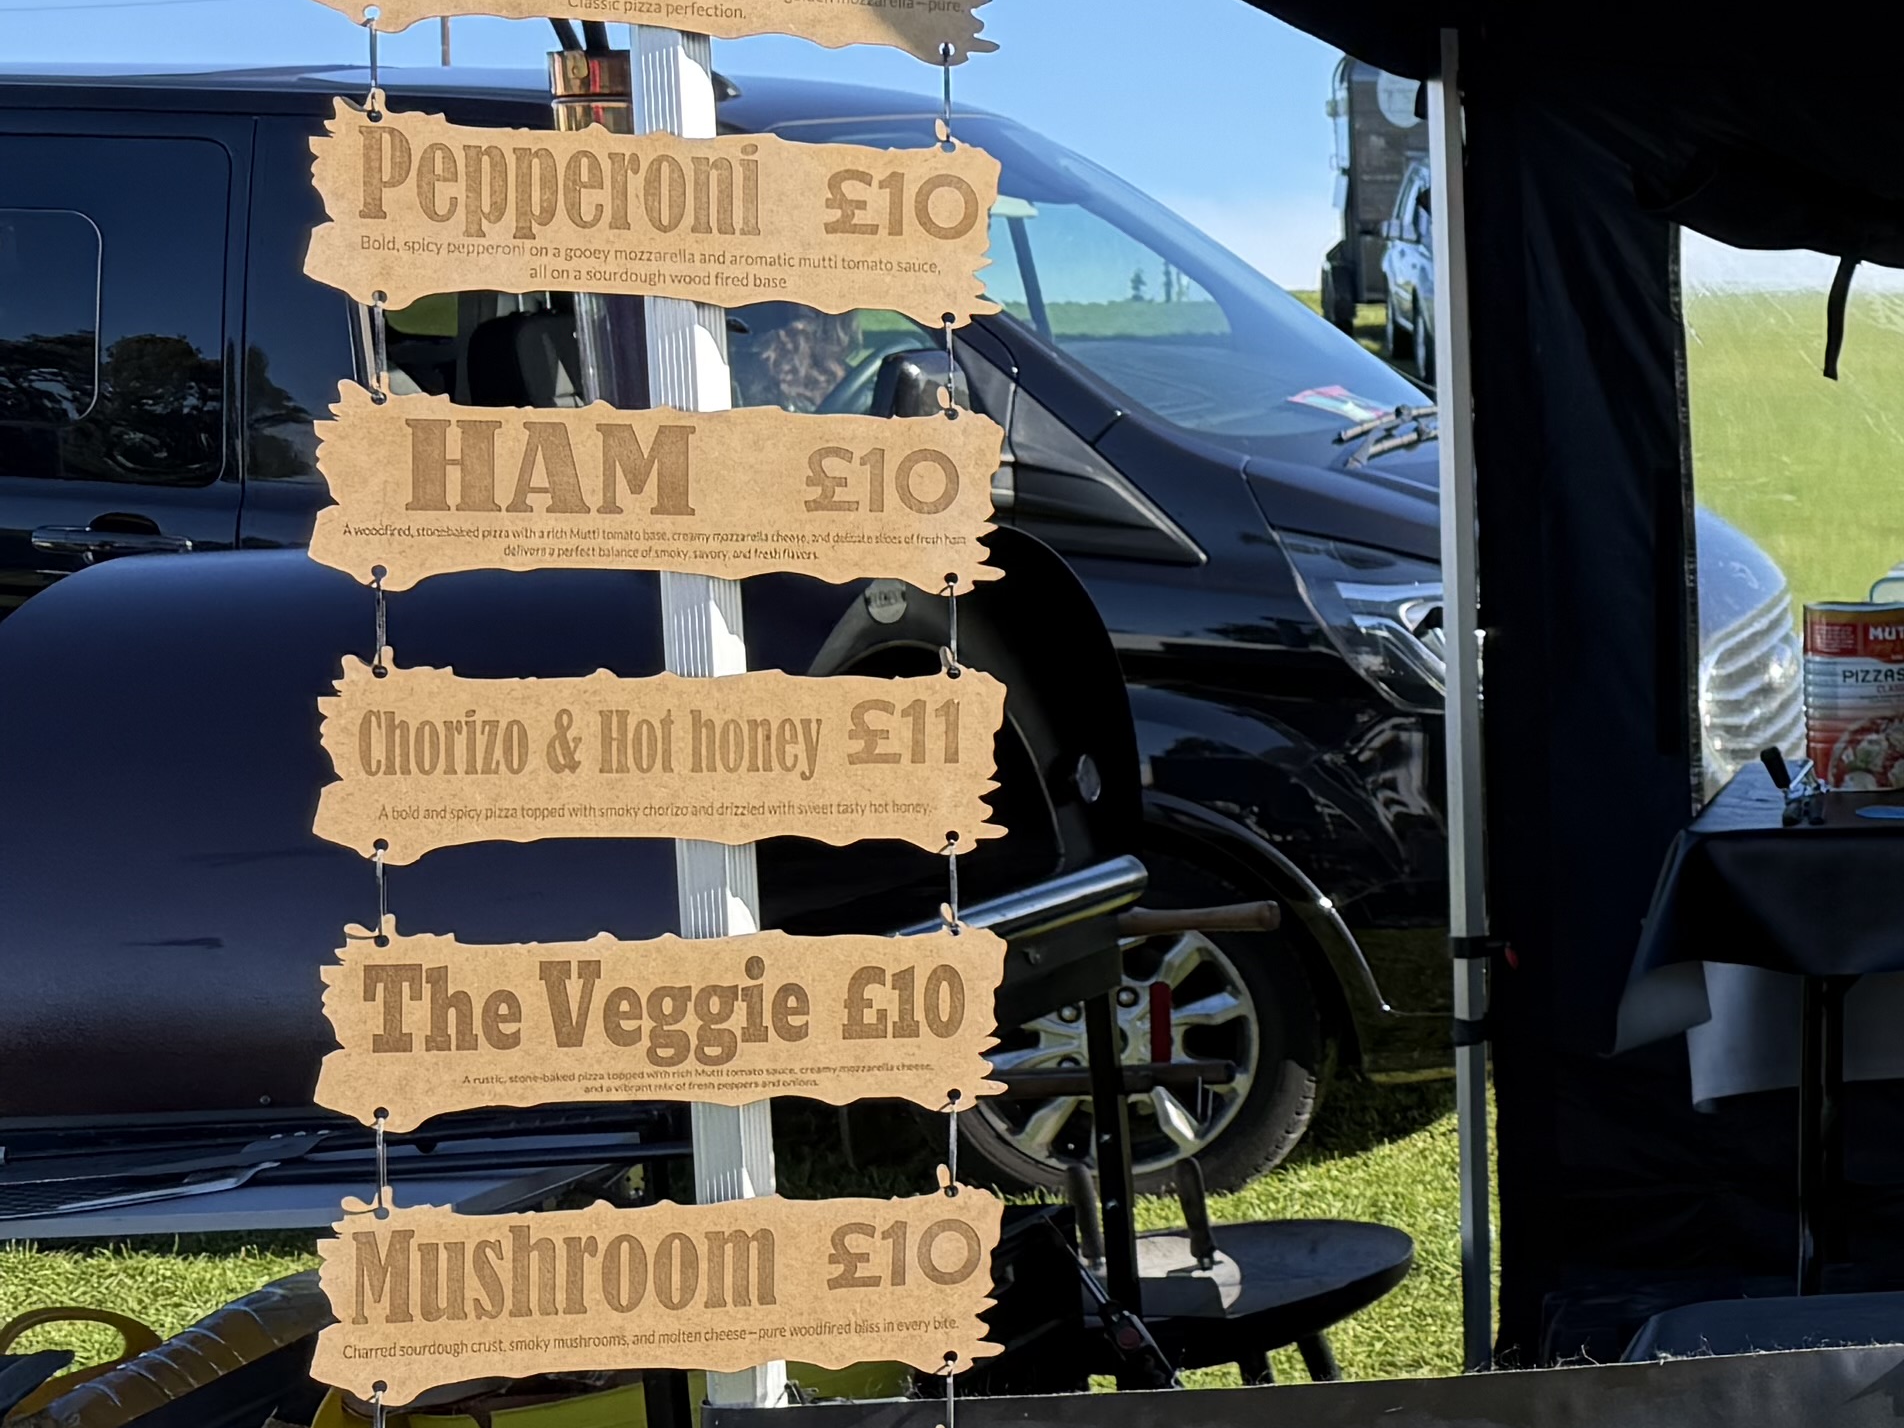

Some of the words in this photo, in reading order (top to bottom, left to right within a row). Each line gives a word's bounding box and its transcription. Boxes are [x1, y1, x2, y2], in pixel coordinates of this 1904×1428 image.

[624, 0, 662, 15] pizza
[666, 1, 746, 20] perfection.
[358, 126, 761, 239] Pepperoni
[824, 170, 978, 239] £10
[361, 235, 399, 252] Bold,
[404, 238, 442, 255] spicy
[447, 242, 525, 258] pepperoni
[530, 244, 548, 257] on
[553, 246, 561, 257] a
[565, 247, 608, 262] gooey
[615, 249, 695, 264] mozzarella
[699, 250, 726, 265] and
[730, 253, 794, 268] aromatic
[799, 254, 838, 269] mutti
[842, 258, 892, 272] tomato
[896, 260, 941, 275] sauce,
[529, 265, 547, 279] all
[551, 268, 569, 280] on
[573, 269, 581, 280] a
[586, 266, 666, 286] sourdough
[670, 272, 710, 286] wood
[715, 272, 749, 287] fired
[753, 273, 787, 289] base
[405, 418, 696, 516] HAM
[805, 446, 959, 514] £10
[357, 707, 529, 777] Chorizo
[546, 709, 583, 773] &
[599, 707, 674, 775] Hot
[690, 709, 822, 781] honey
[847, 699, 960, 765] £11
[379, 805, 388, 820] A
[392, 805, 419, 820] bold
[423, 805, 446, 820] and
[450, 806, 482, 822] spicy
[485, 806, 517, 821] pizza
[521, 805, 565, 820] topped
[568, 804, 596, 817] with
[599, 805, 640, 820] smoky
[643, 802, 689, 817] chorizo
[691, 802, 713, 816] and
[717, 802, 764, 816] drizzled
[768, 801, 796, 815] with
[799, 802, 833, 815] sweet
[837, 802, 866, 816] tasty
[869, 801, 888, 814] hot
[362, 964, 522, 1054] The
[539, 954, 810, 1068] Veggie
[842, 964, 966, 1041] £10
[352, 1224, 777, 1326] Mushroom
[827, 1218, 981, 1292] £10
[343, 1343, 396, 1359] Charred
[399, 1340, 468, 1358] sourdough
[509, 1337, 550, 1353] smoky
[553, 1333, 629, 1351] mushrooms,
[632, 1331, 655, 1346] and
[658, 1330, 701, 1345] molten
[789, 1322, 850, 1338] woodfired
[854, 1320, 880, 1335] bliss
[884, 1319, 894, 1333] in
[897, 1319, 930, 1335] every
[934, 1316, 959, 1331] bite.
